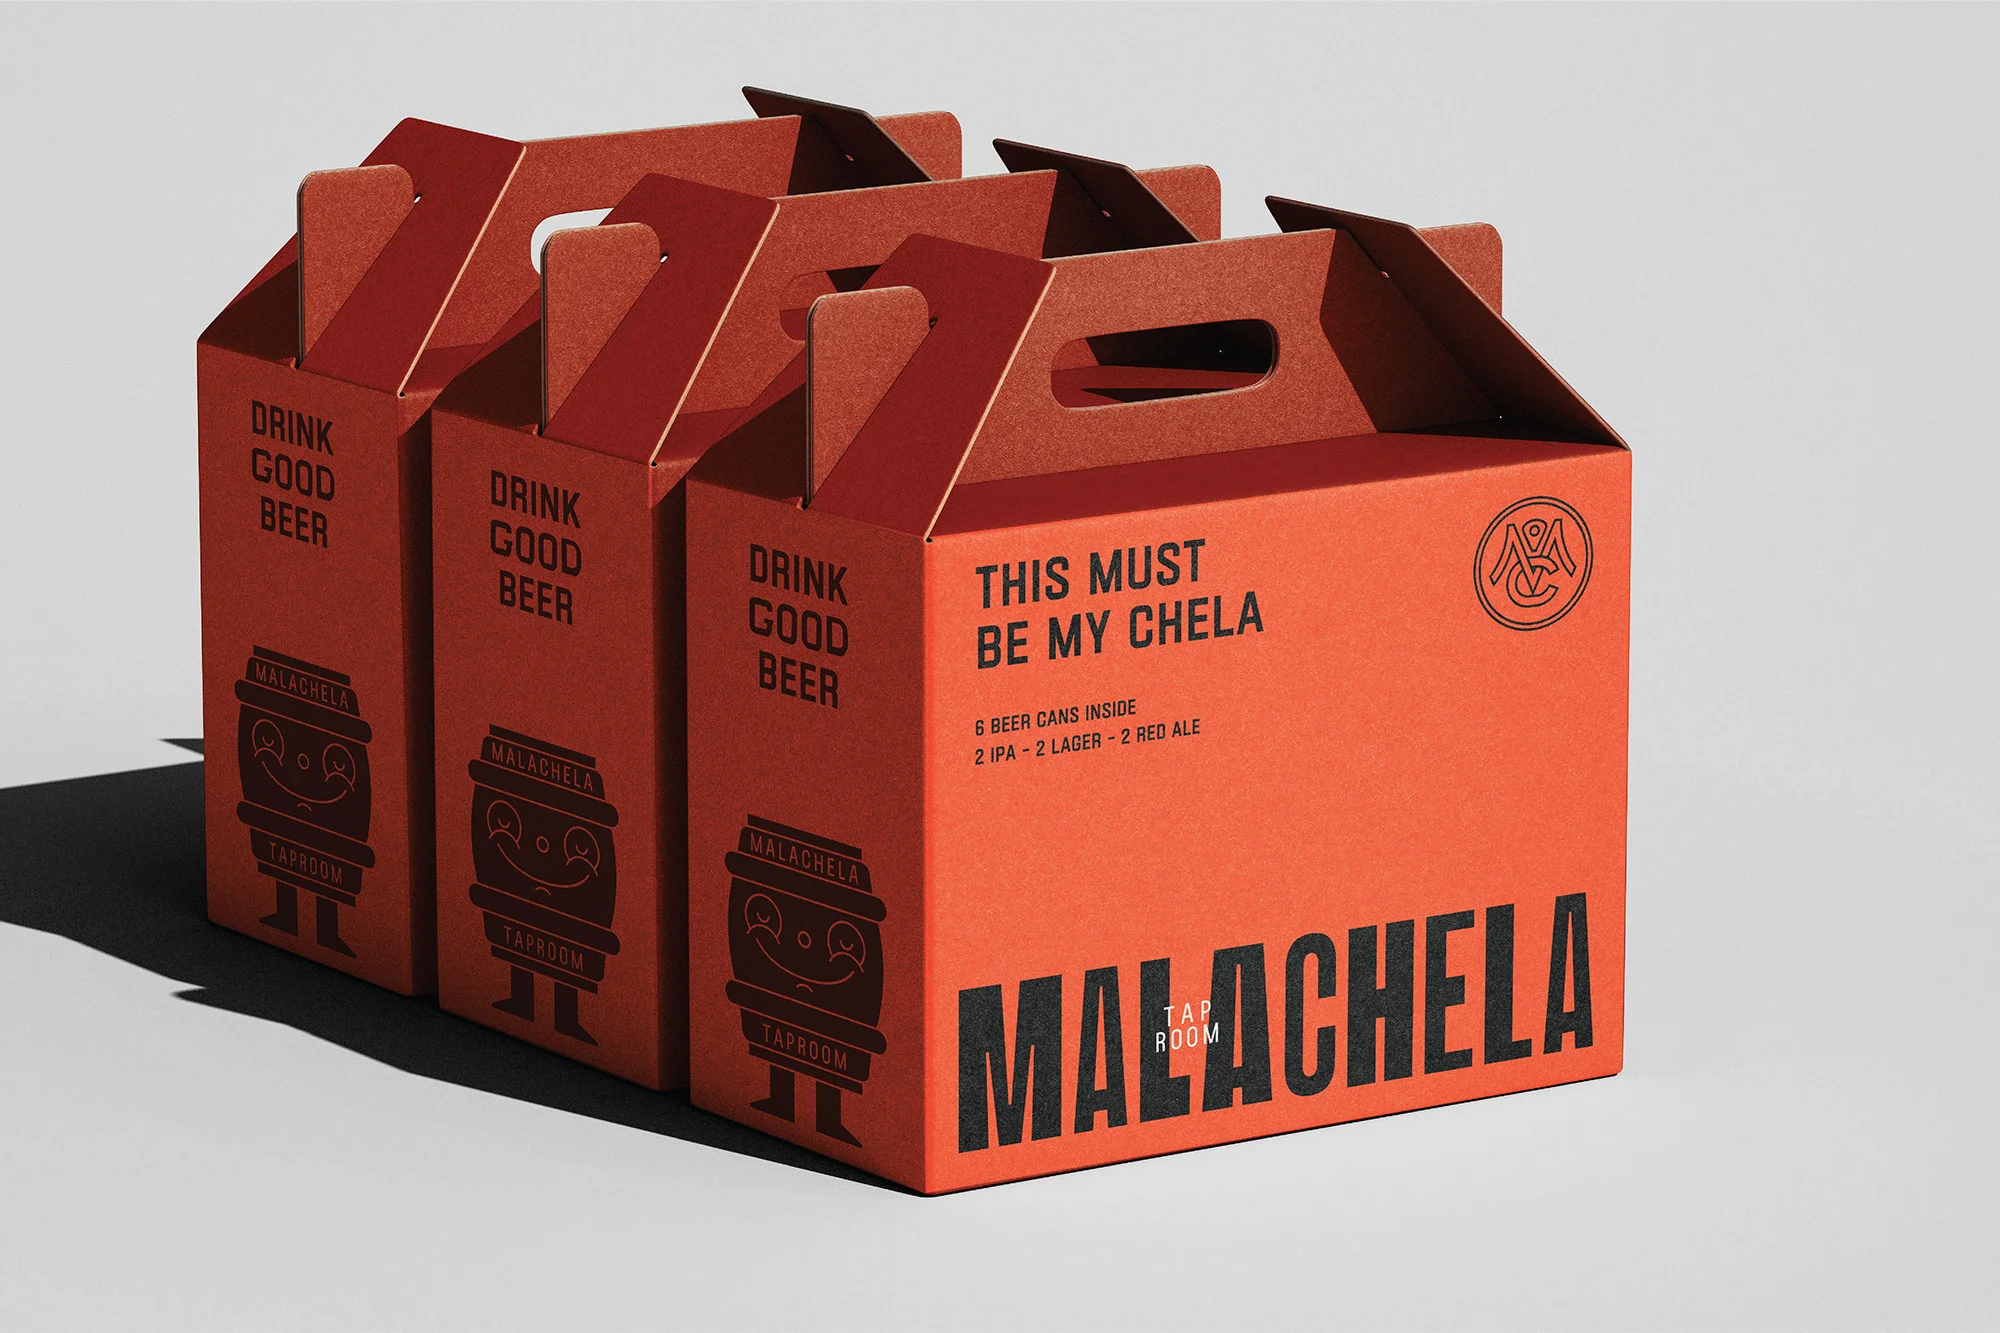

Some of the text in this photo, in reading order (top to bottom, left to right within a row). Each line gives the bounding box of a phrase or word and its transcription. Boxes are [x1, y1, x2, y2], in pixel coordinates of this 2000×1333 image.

[252, 400, 333, 455] DRINK
[252, 448, 335, 500] GOOD
[491, 470, 581, 528] DRINK
[261, 496, 328, 548] BEER
[490, 520, 582, 576] GOOD
[500, 571, 572, 624] BEER
[750, 544, 848, 606] DRINK
[975, 538, 1206, 609] THIS MUST
[749, 597, 849, 657] GOOD
[978, 591, 1264, 669] BE MY CHELA
[256, 663, 349, 709] MALACHELA
[758, 650, 839, 709] BEER
[975, 699, 1137, 736] 6 BEER CANS INSIDE
[975, 748, 984, 765] 2
[990, 744, 1017, 763] IPA
[1036, 740, 1045, 757] 2
[1050, 733, 1102, 754] LAGER
[1121, 729, 1130, 745] 2
[1137, 722, 1166, 742] RED
[1171, 718, 1200, 738] ALE
[491, 741, 593, 792] MALACHELA
[269, 841, 343, 884] TAPROOM
[750, 832, 860, 885] MALACHELA
[503, 926, 584, 971] TAPROOM
[958, 892, 1593, 1153] MALACHELA
[1156, 1023, 1220, 1052] ROOM
[1164, 1000, 1212, 1026] TAP
[762, 1023, 848, 1070] TAPROOM
